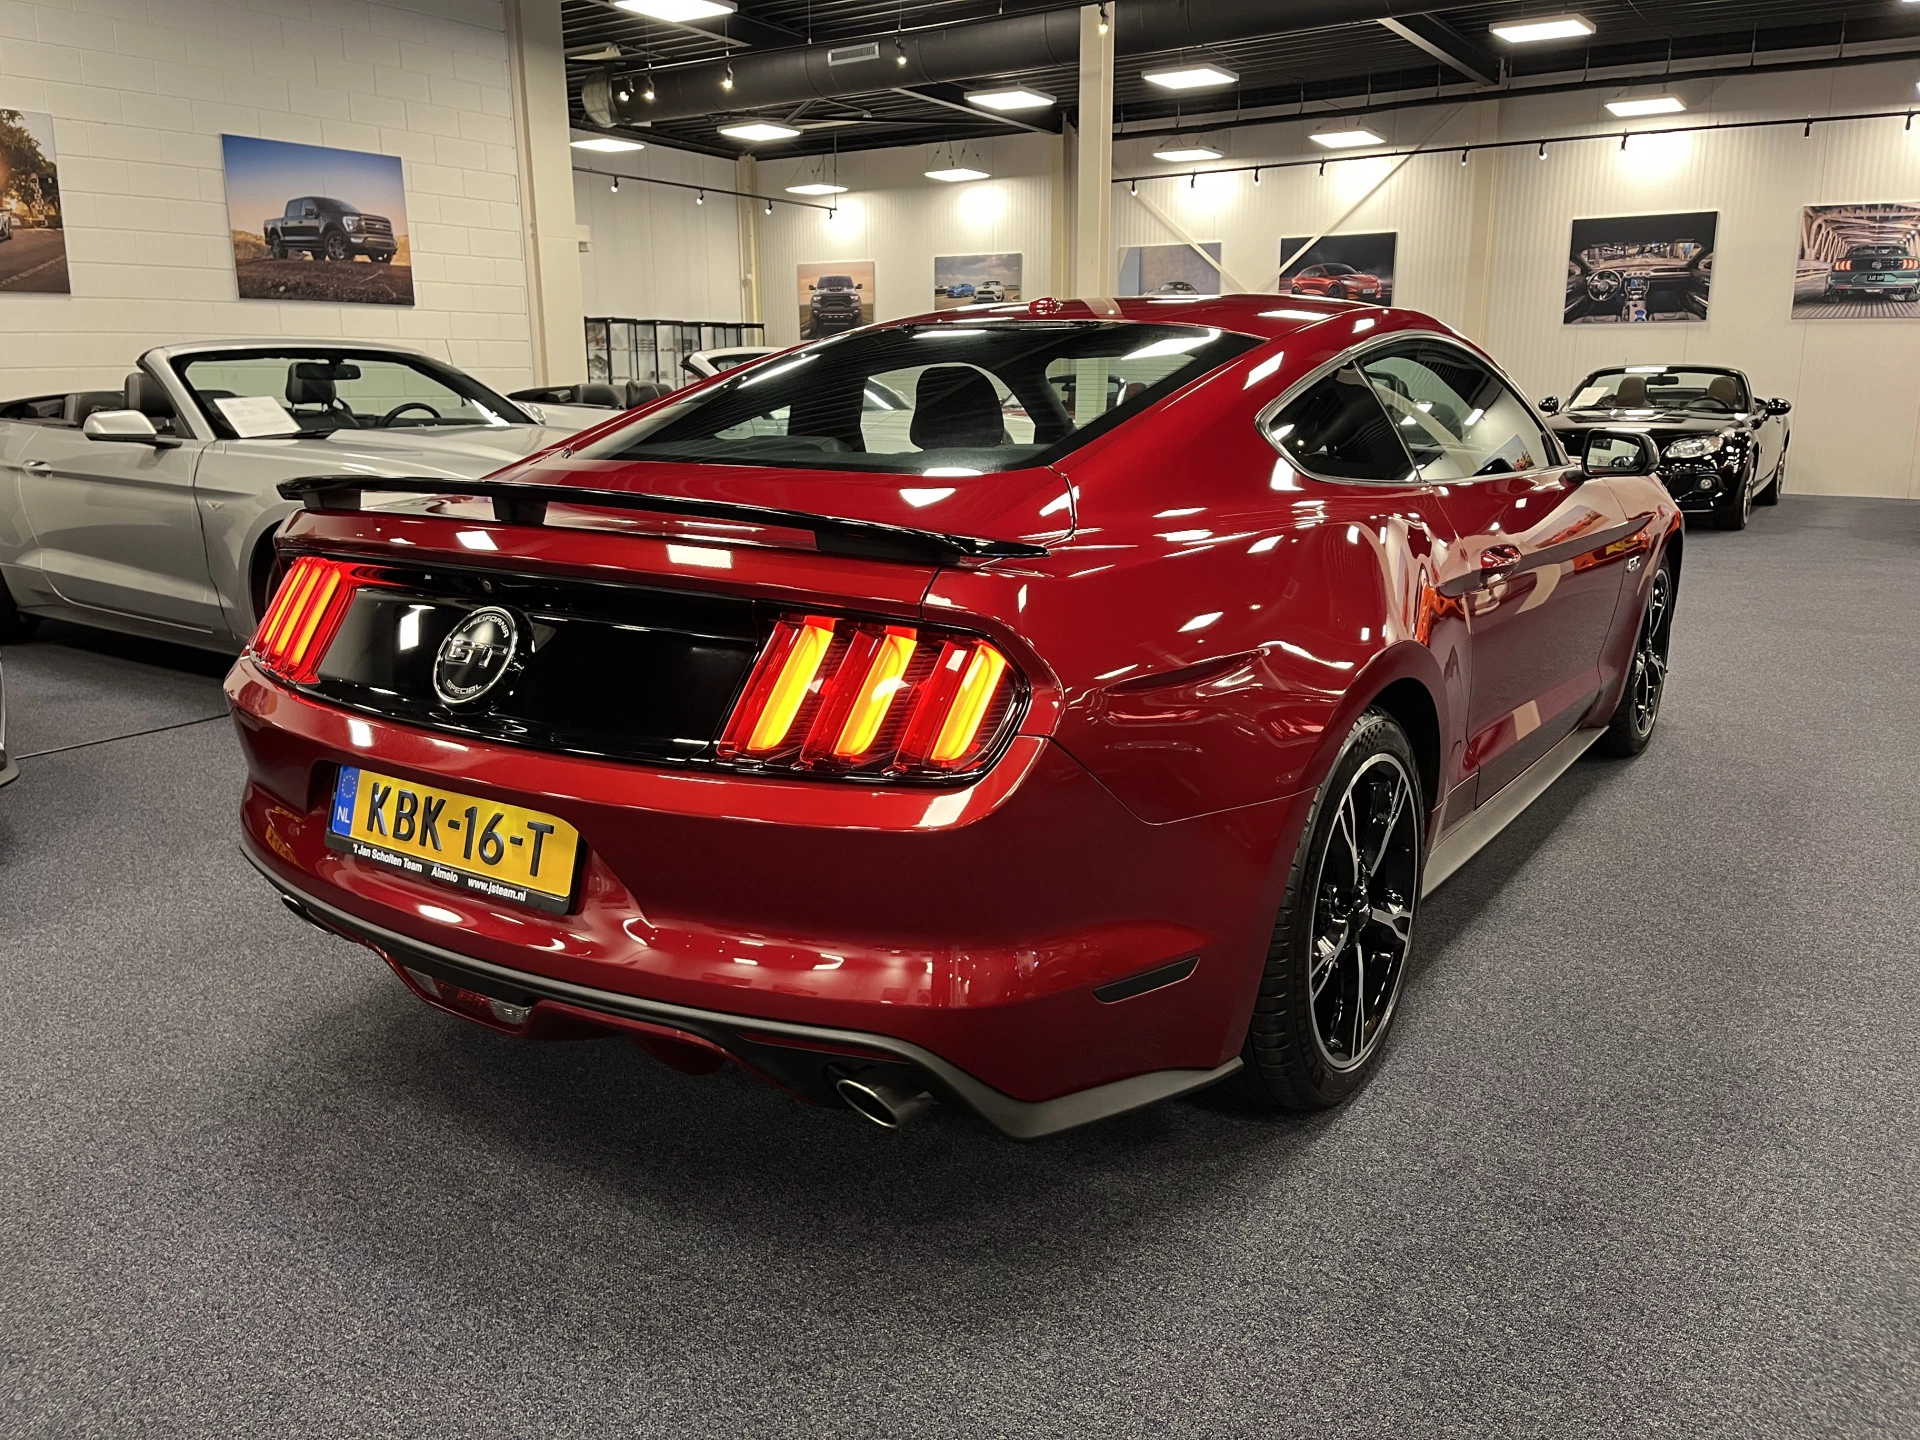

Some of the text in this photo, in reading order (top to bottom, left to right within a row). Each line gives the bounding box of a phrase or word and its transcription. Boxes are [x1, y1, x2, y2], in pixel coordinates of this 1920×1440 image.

[463, 615, 510, 638] CALIFORNIA
[445, 639, 509, 668] GT
[446, 679, 482, 695] SPECIAL
[337, 805, 350, 824] NL
[367, 782, 554, 877] KBK-16-T
[358, 845, 371, 857] Jan
[372, 848, 402, 867] Scholten
[403, 857, 423, 872] Team
[431, 866, 458, 883] Almelo
[467, 878, 526, 902] www.jsteam.nl
